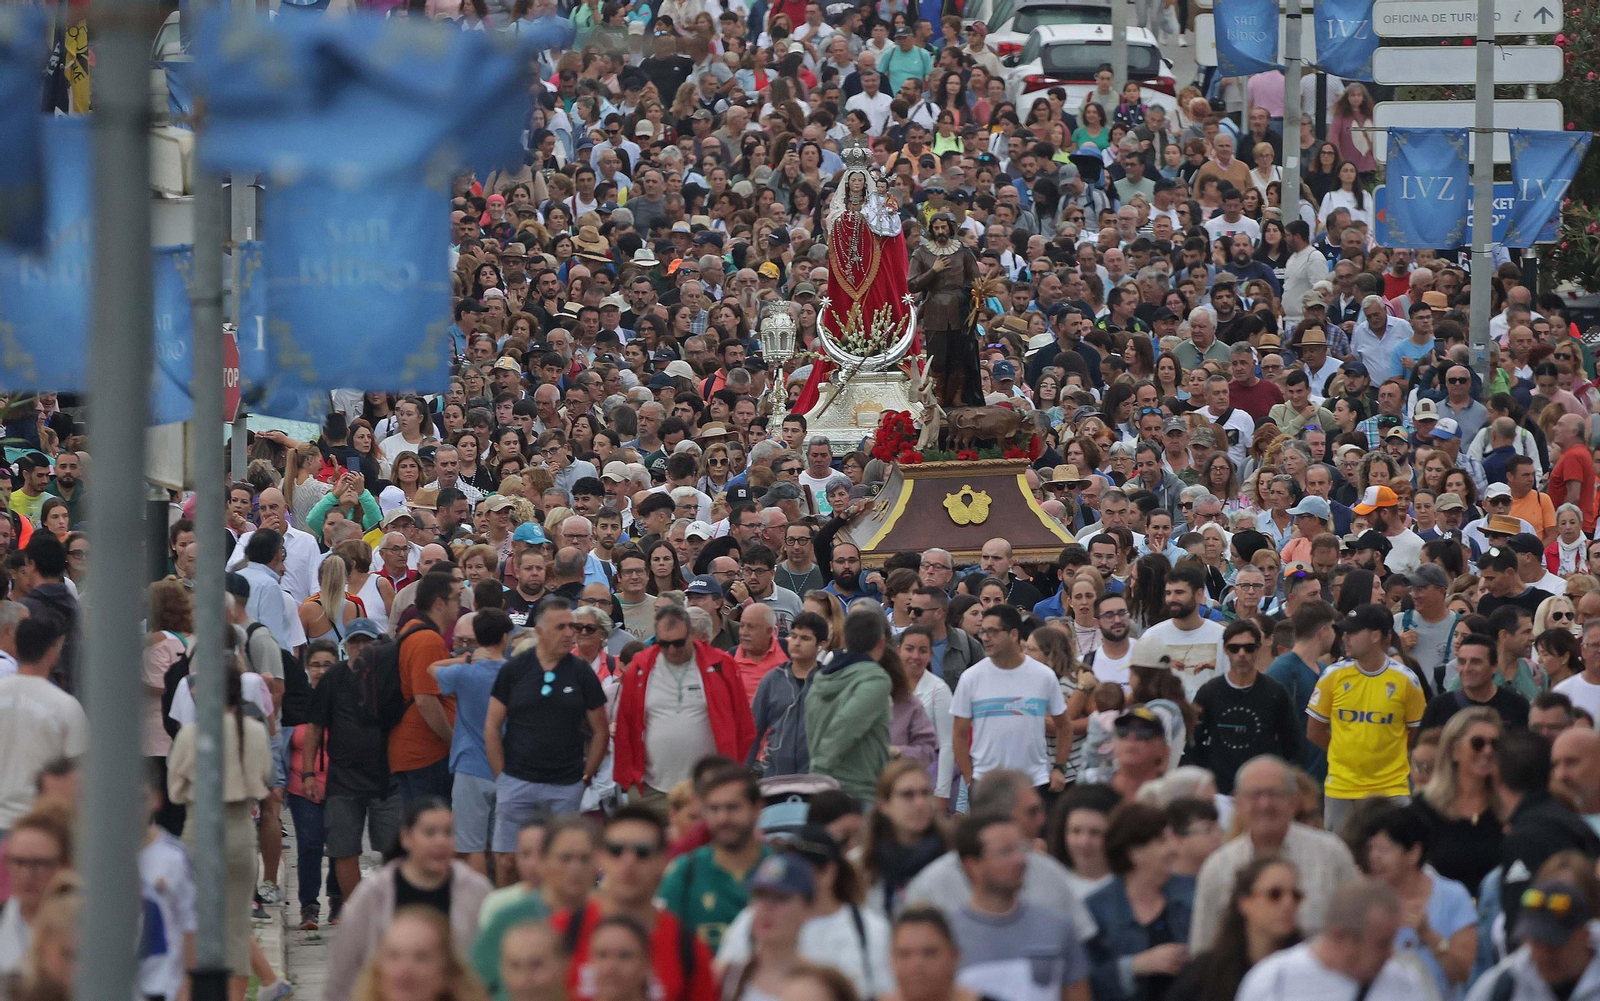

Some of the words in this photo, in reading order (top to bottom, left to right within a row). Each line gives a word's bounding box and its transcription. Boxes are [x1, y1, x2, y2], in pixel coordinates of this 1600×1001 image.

[1383, 13, 1429, 24] OFICINA
[1431, 13, 1447, 23] DE
[1451, 12, 1502, 22] TURIO
[1326, 19, 1369, 40] LVZ
[1400, 175, 1455, 201] LVZ
[1520, 178, 1572, 202] LVZ
[222, 367, 240, 388] TOP
[1338, 708, 1394, 725] DIGI
